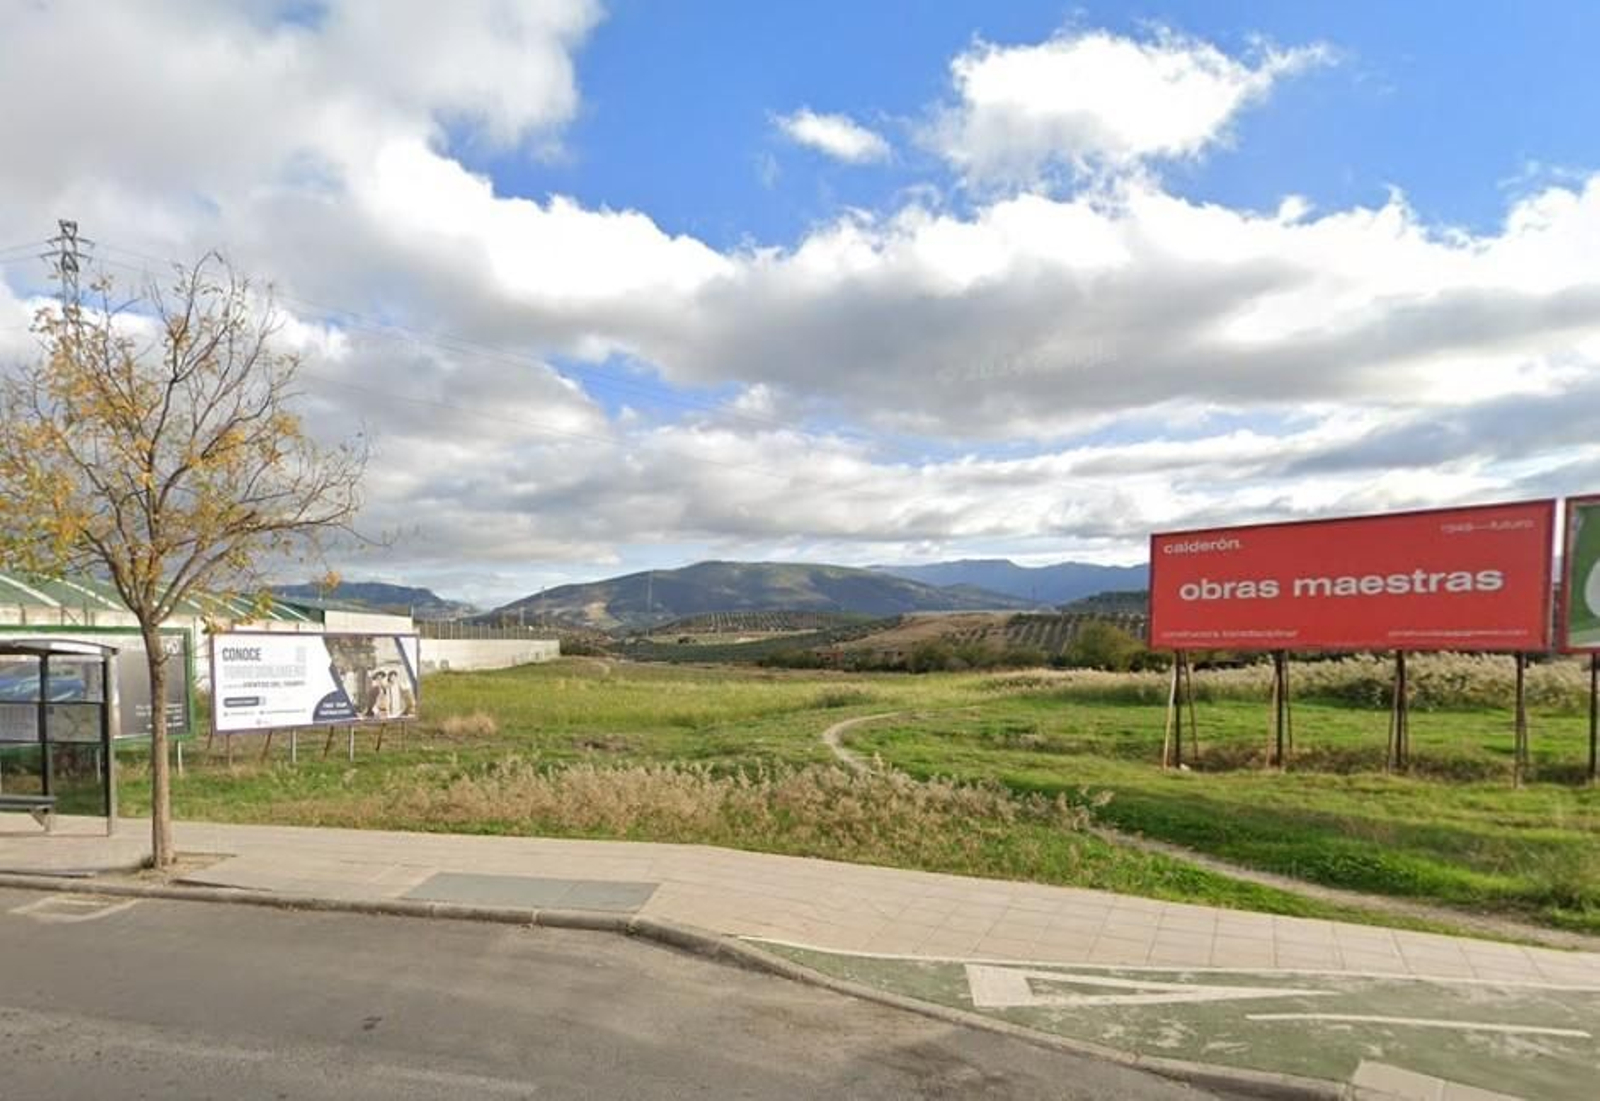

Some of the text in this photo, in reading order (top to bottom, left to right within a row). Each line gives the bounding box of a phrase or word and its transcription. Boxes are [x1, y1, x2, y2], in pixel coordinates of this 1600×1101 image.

[1179, 569, 1504, 601] obras maestras
[222, 647, 262, 662] CONOCE
